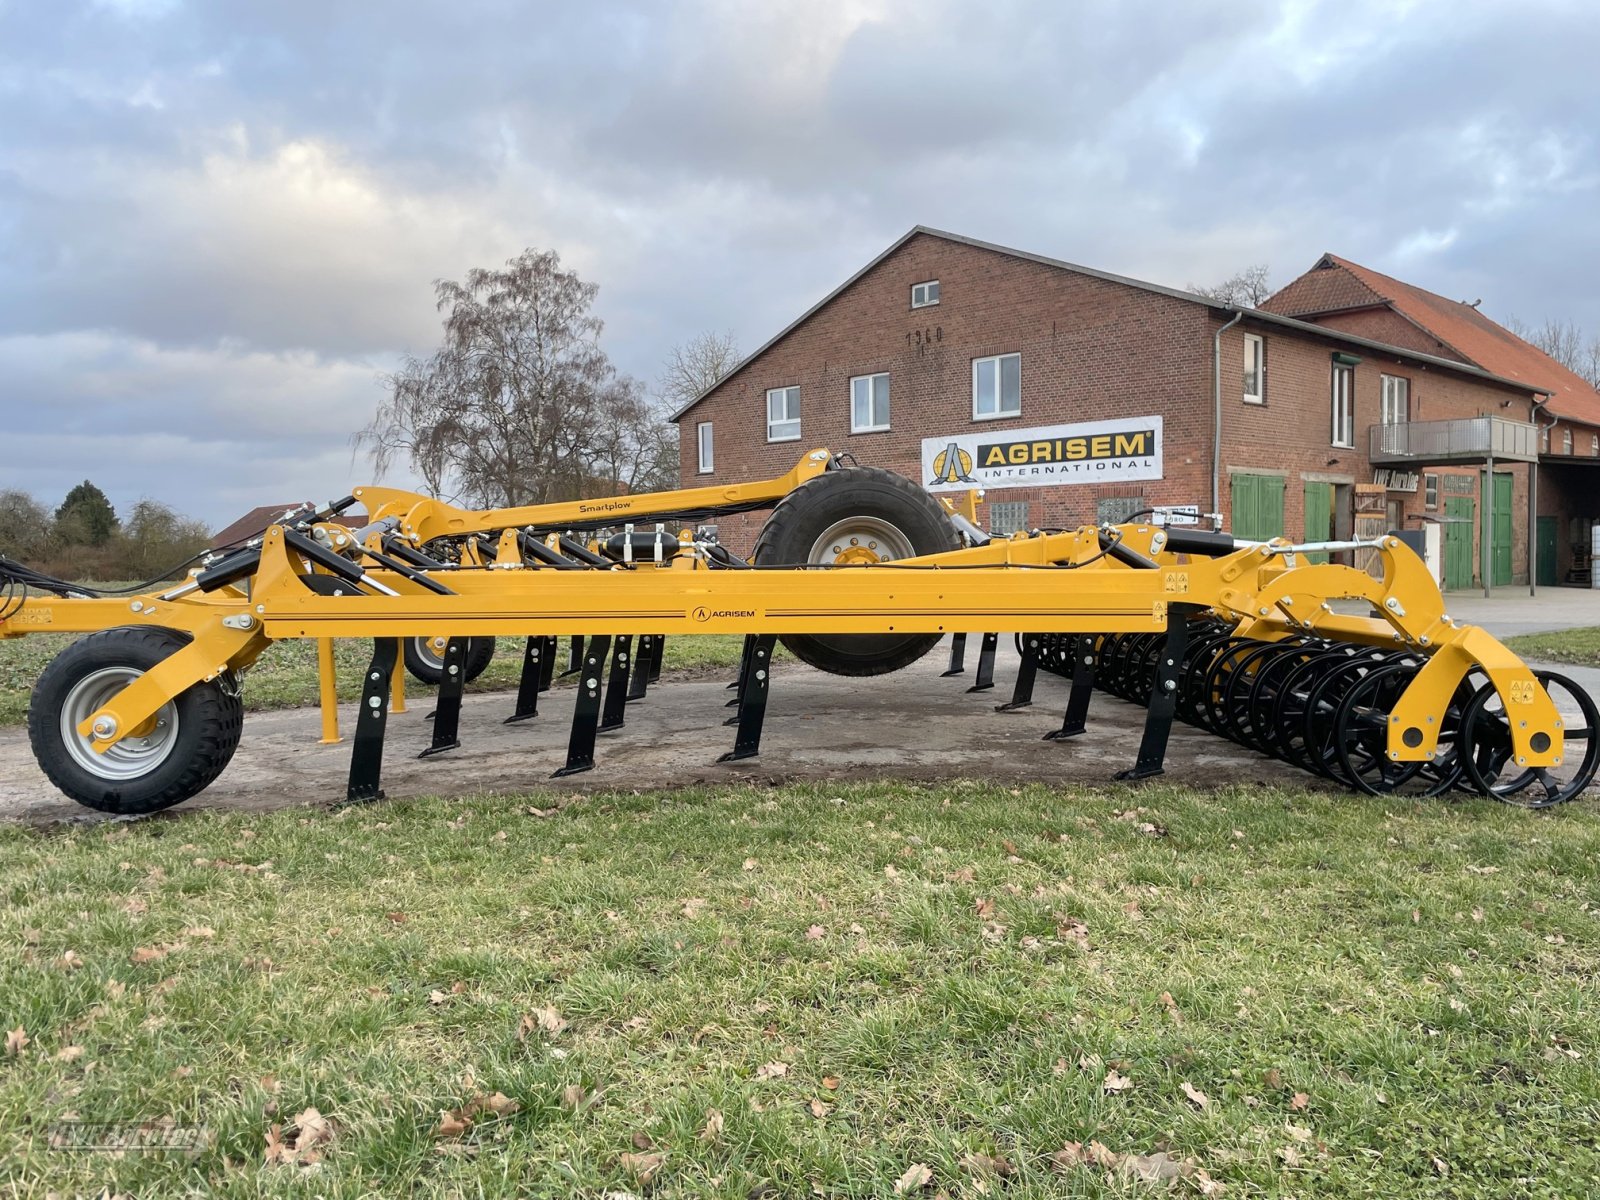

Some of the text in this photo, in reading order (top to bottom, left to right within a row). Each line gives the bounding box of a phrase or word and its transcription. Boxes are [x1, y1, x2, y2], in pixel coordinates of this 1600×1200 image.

[985, 432, 1147, 466] AGRISEM
[984, 460, 1152, 478] INTERNATIONAL
[579, 502, 631, 512] Smartplow
